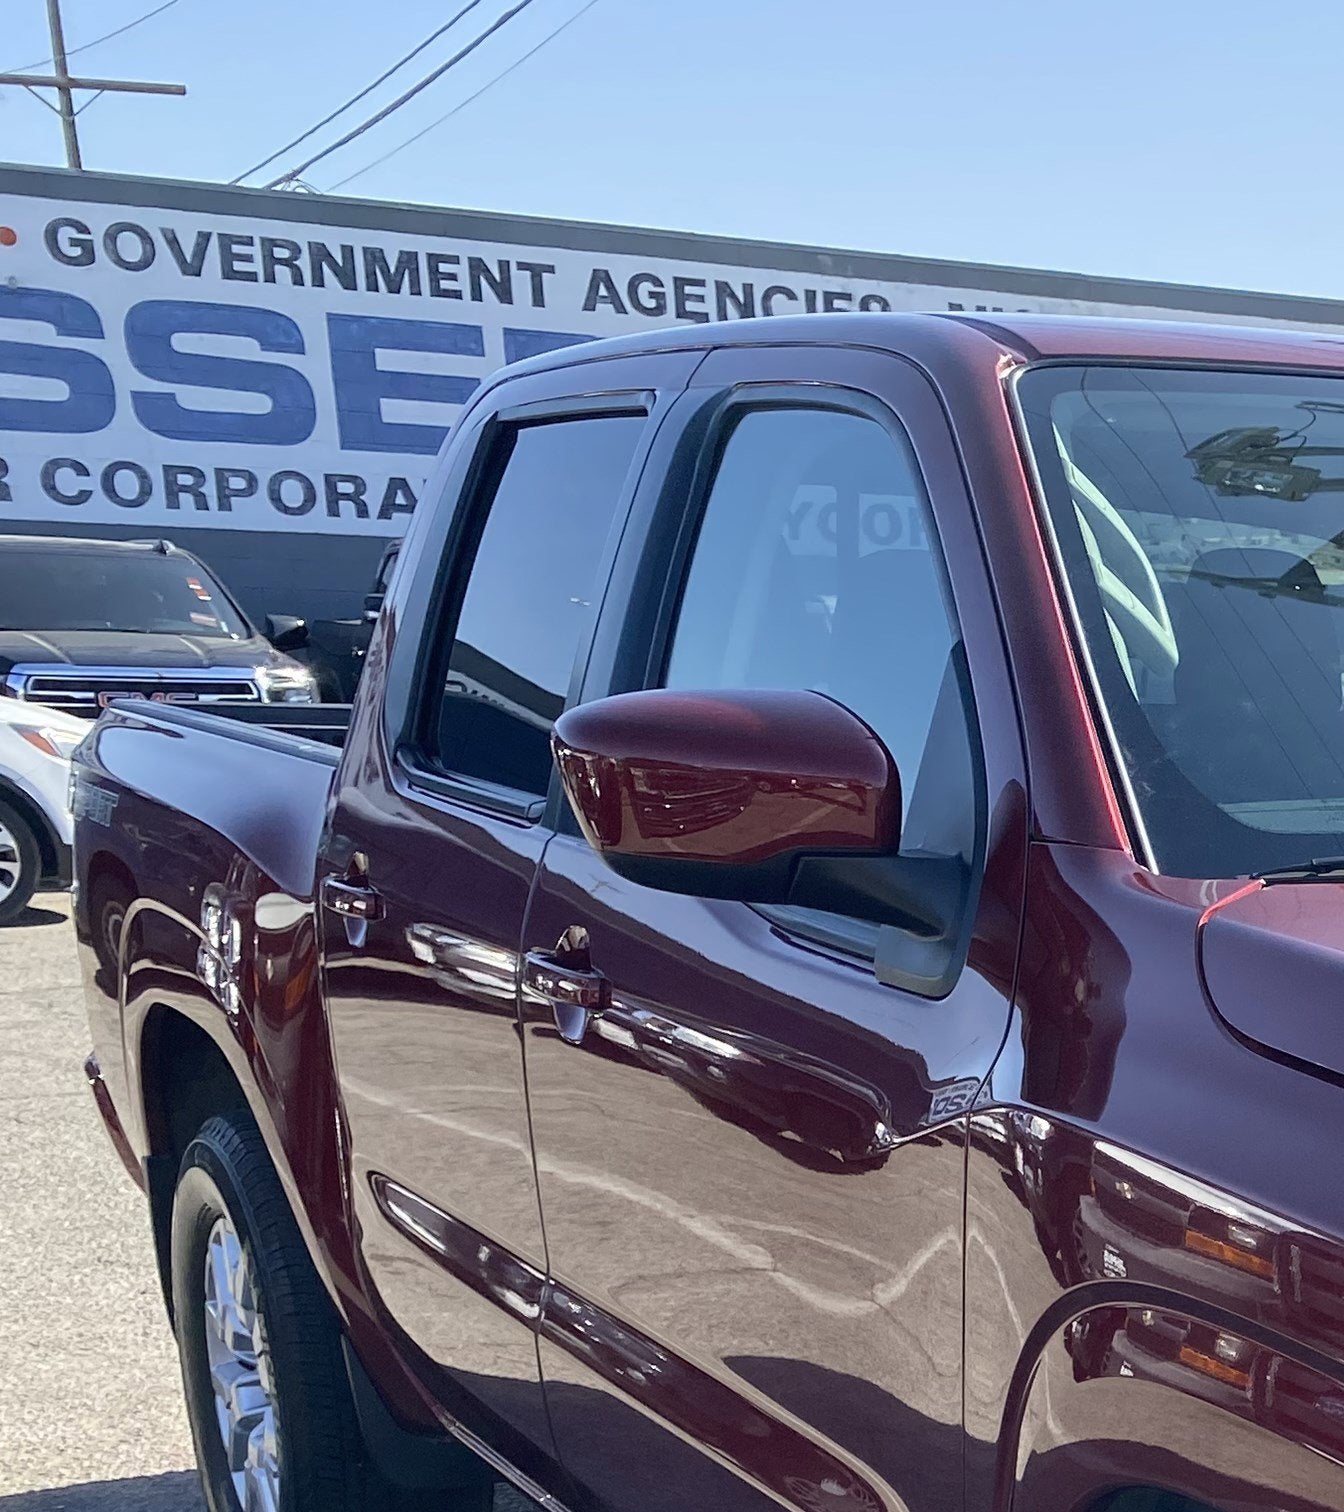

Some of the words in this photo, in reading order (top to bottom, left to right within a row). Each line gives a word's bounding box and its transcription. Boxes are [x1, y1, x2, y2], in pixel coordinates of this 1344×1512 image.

[43, 216, 556, 308] GOVERNMENT
[0, 283, 605, 457] SSE
[40, 456, 428, 521] CORPORA
